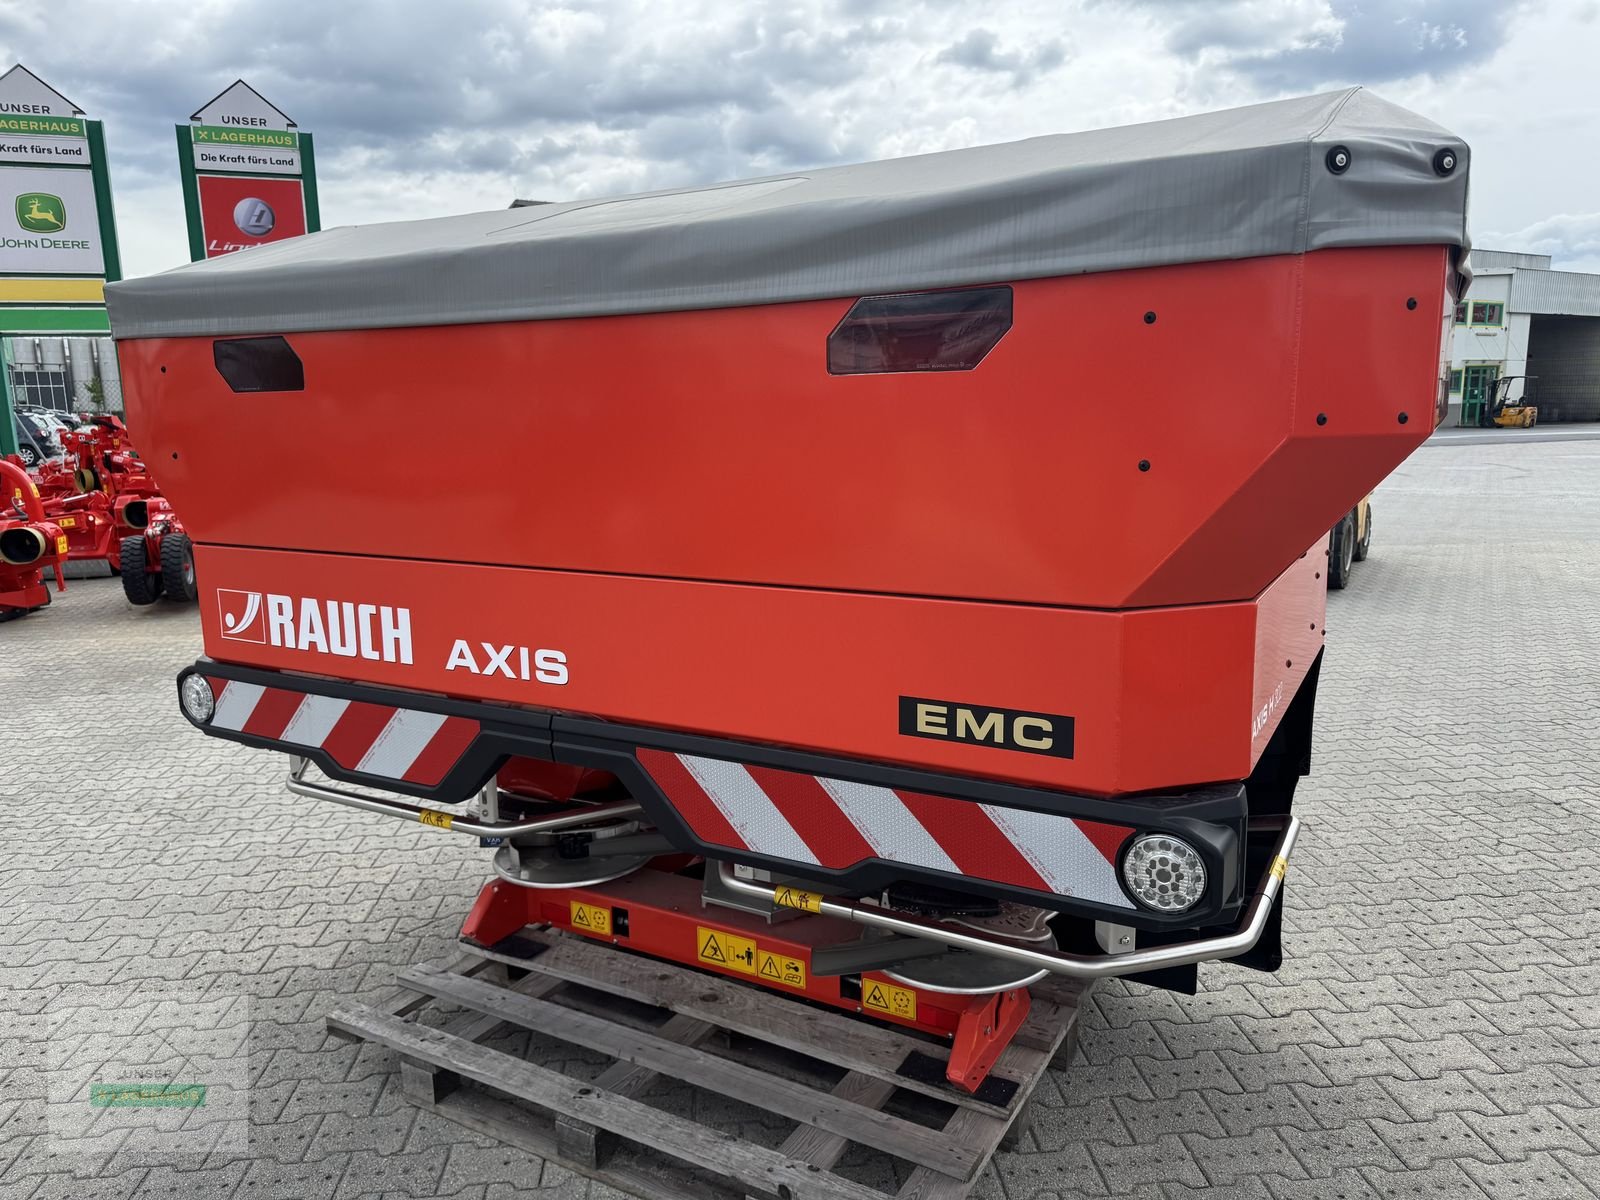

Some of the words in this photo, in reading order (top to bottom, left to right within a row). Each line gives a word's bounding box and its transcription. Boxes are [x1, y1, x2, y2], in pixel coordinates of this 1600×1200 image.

[0, 103, 51, 115] UNSER
[221, 115, 267, 127] UNSER
[212, 131, 293, 145] LAGERHAUS
[0, 143, 28, 154] Kraft
[31, 145, 53, 155] fürs
[55, 146, 82, 156] Land
[201, 153, 217, 162] Die
[219, 154, 246, 164] Kraft
[248, 155, 268, 165] fürs
[270, 157, 294, 166] Land
[0, 237, 39, 249] JOHN
[41, 237, 91, 250] DEERE
[266, 593, 414, 665] RAUCH
[445, 639, 570, 685] AXIS
[916, 703, 1053, 750] EMC
